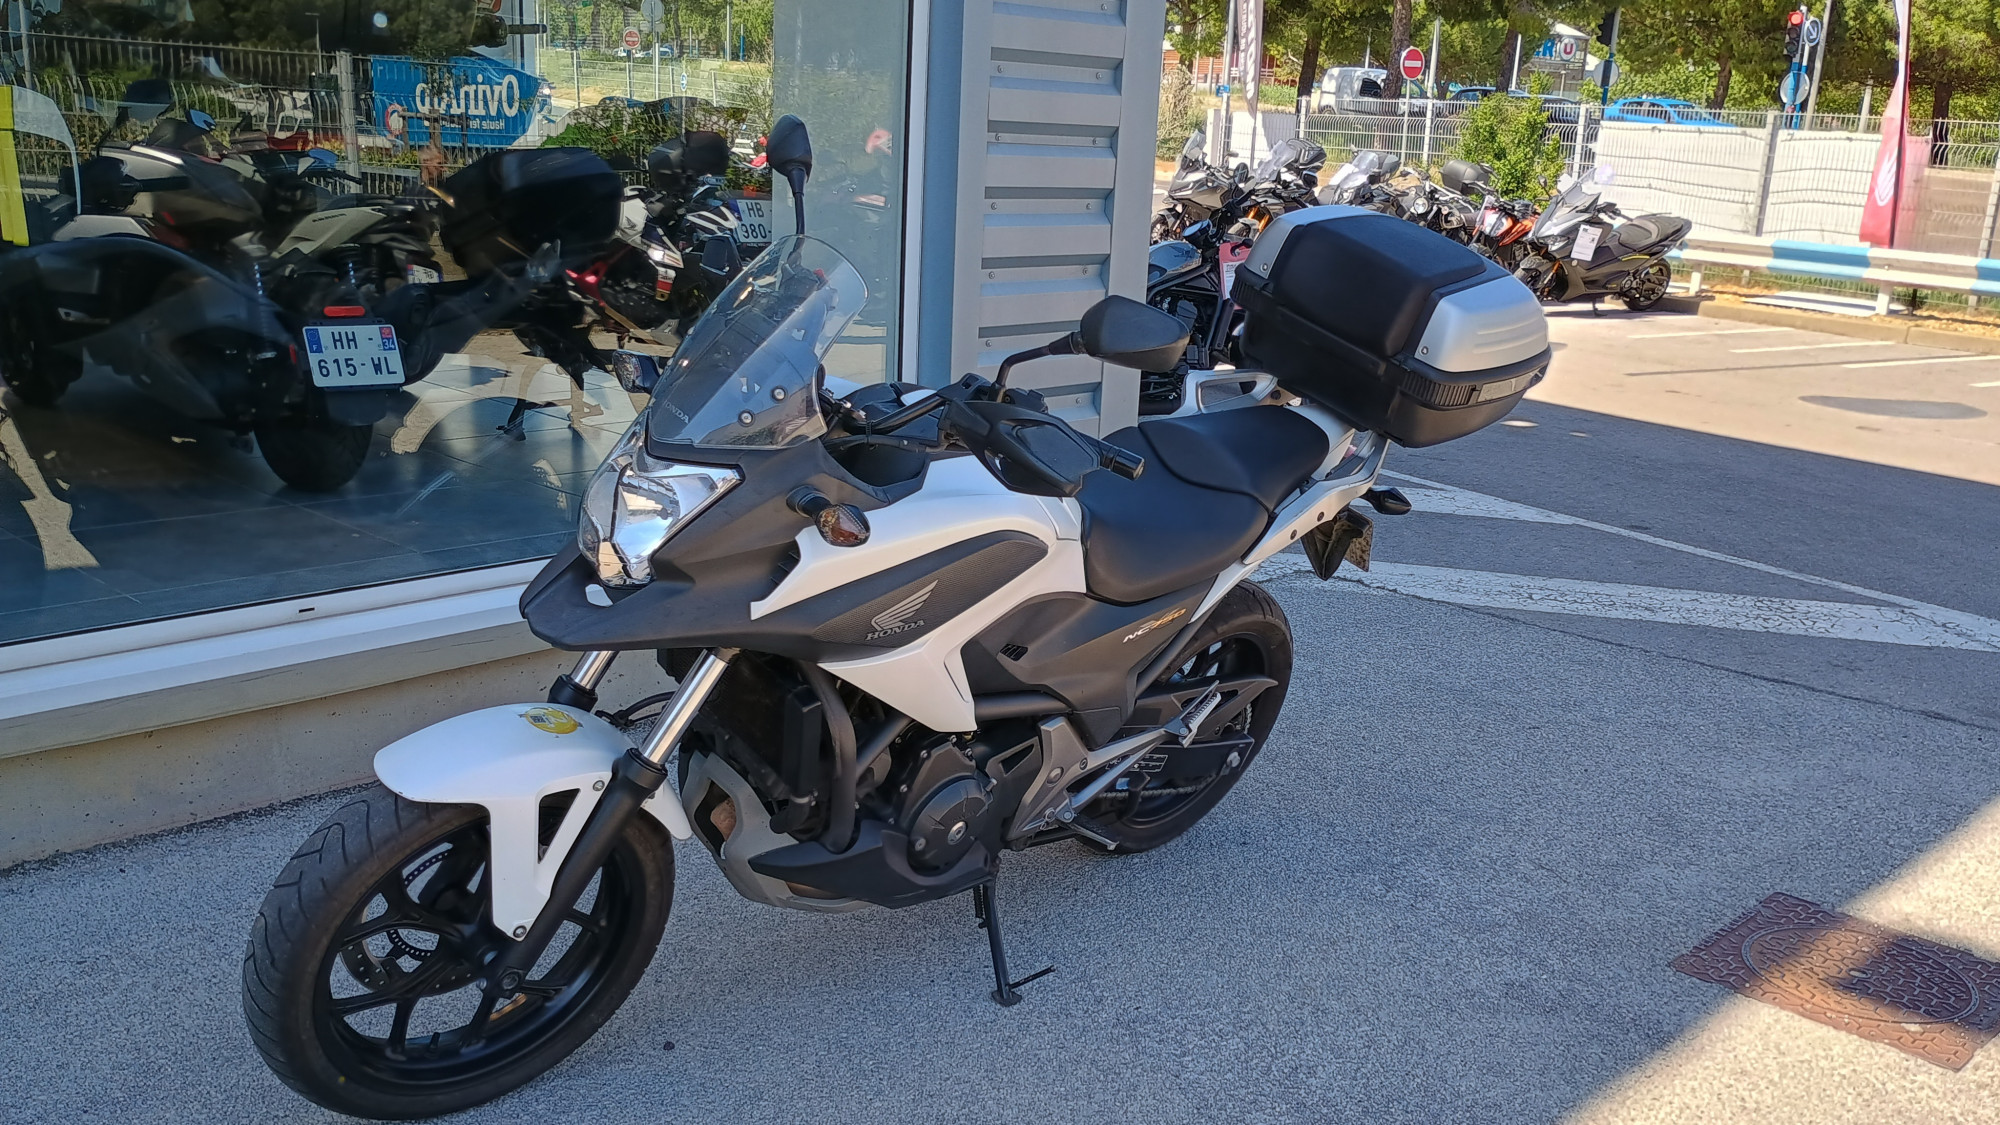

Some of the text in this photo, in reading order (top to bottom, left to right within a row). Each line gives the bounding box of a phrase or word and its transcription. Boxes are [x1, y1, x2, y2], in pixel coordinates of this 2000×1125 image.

[745, 202, 764, 218] HB
[382, 338, 395, 350] 34
[865, 620, 925, 641] HONDA
